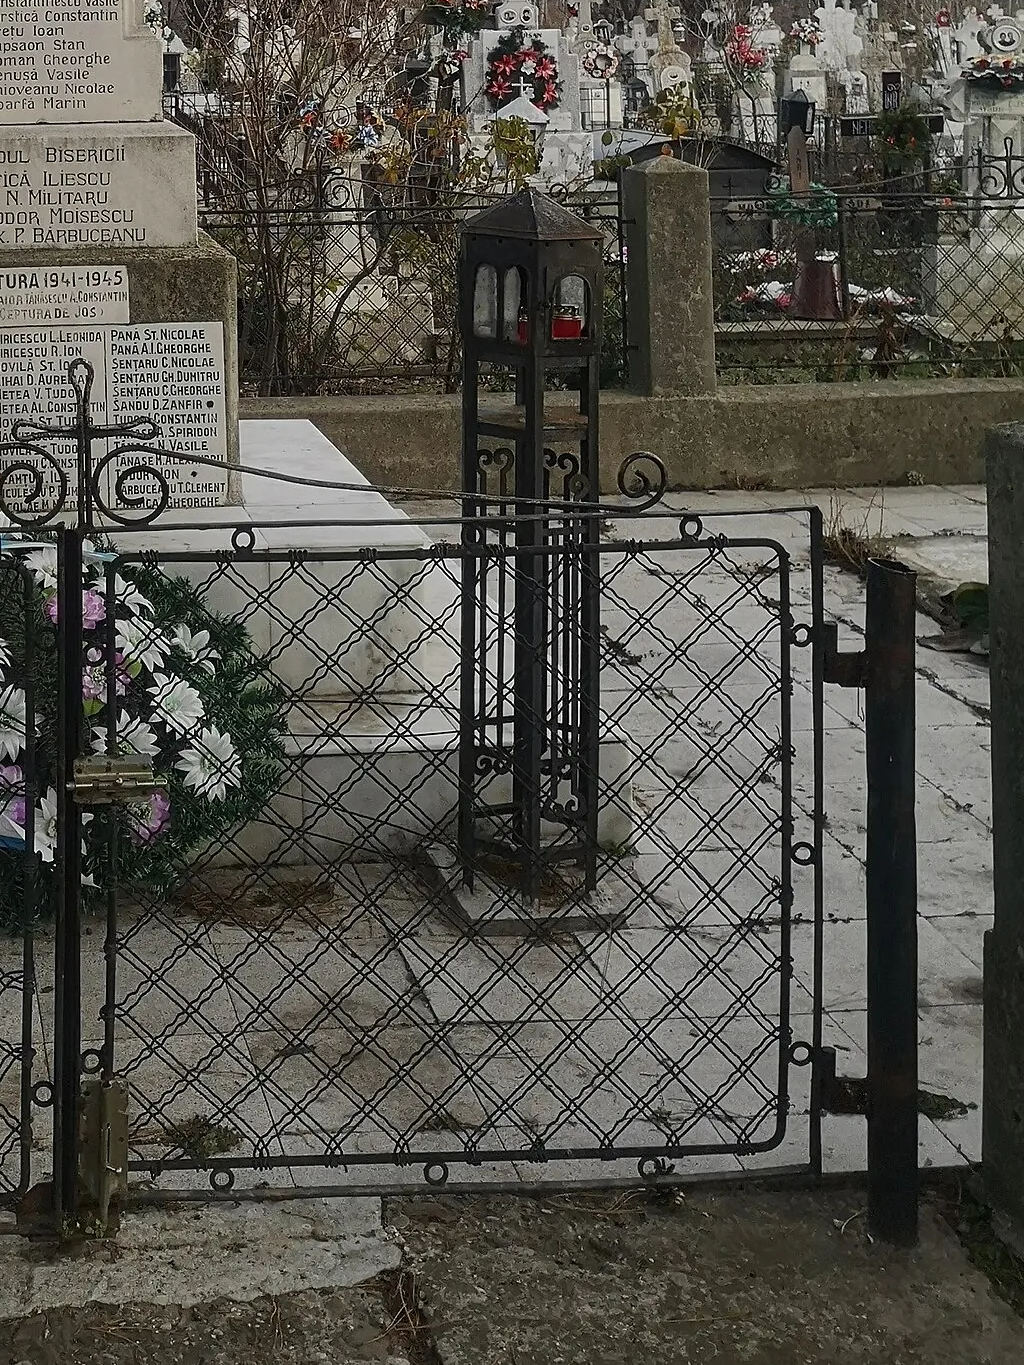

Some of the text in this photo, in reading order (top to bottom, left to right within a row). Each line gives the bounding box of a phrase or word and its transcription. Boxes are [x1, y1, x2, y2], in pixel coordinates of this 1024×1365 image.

[44, 10, 118, 22] Constantin
[33, 25, 64, 37] Ioan
[53, 39, 85, 51] Stan
[43, 51, 111, 69] Gheorghe
[46, 68, 90, 81] Vasile
[64, 83, 115, 94] Nicolae
[43, 96, 86, 109] Marin
[42, 169, 111, 186] ILIESCU
[28, 190, 109, 206] MILITARU
[50, 208, 134, 225] MOISESCU
[54, 308, 70, 319] DE
